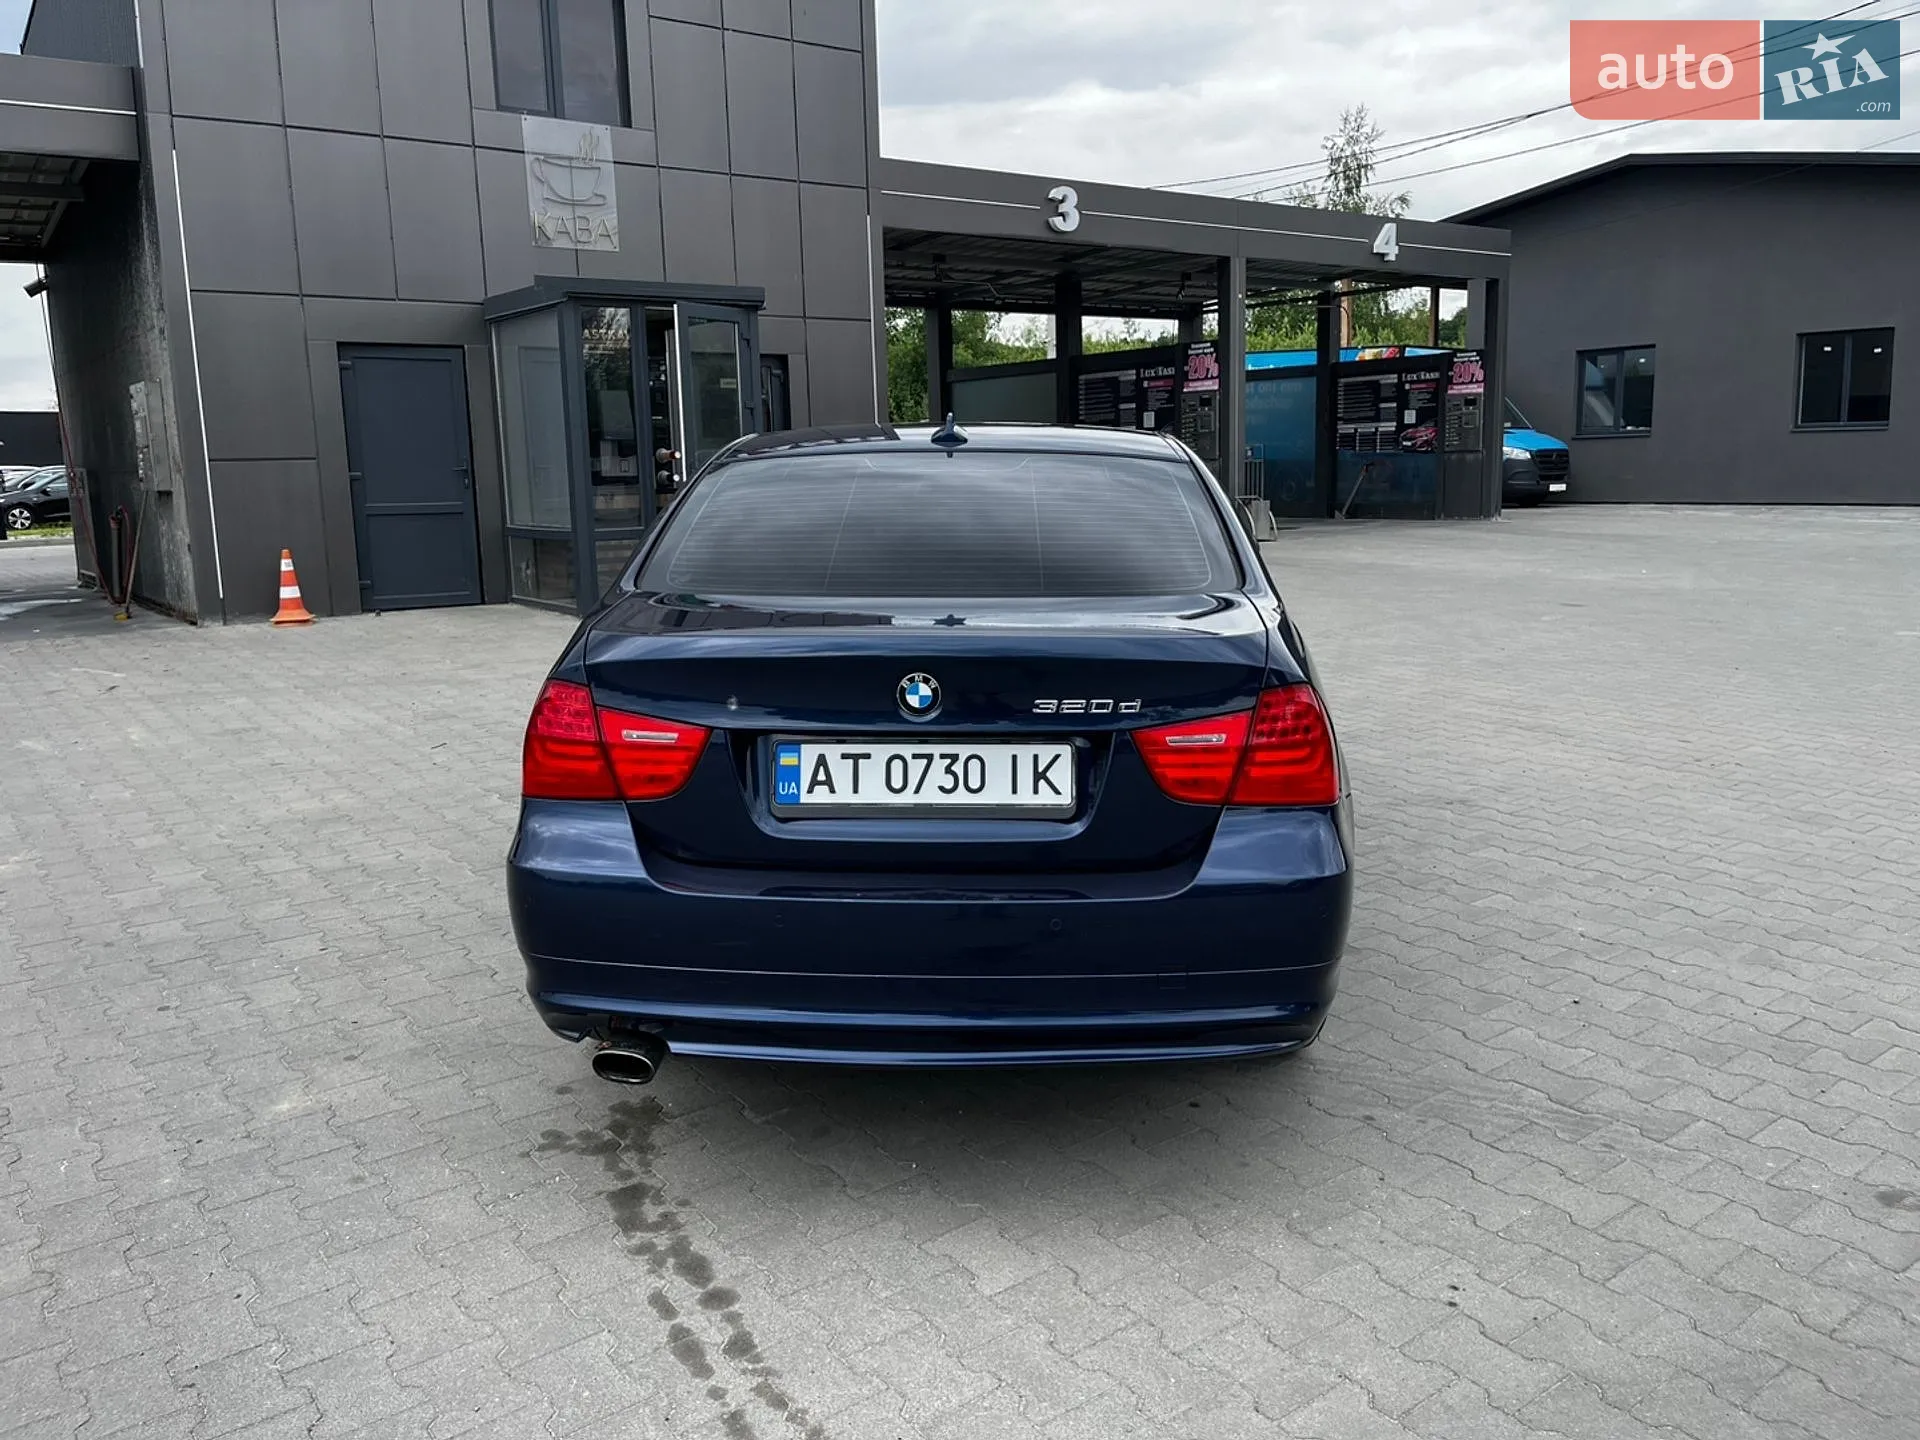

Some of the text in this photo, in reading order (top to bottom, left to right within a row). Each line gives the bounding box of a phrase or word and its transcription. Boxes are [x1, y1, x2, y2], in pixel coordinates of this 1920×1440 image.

[1047, 185, 1081, 233] 3
[1372, 222, 1400, 262] 4
[901, 675, 938, 689] BMW
[1032, 699, 1142, 713] 320d
[806, 753, 1063, 796] AT 0730 IK
[779, 782, 799, 795] UA
